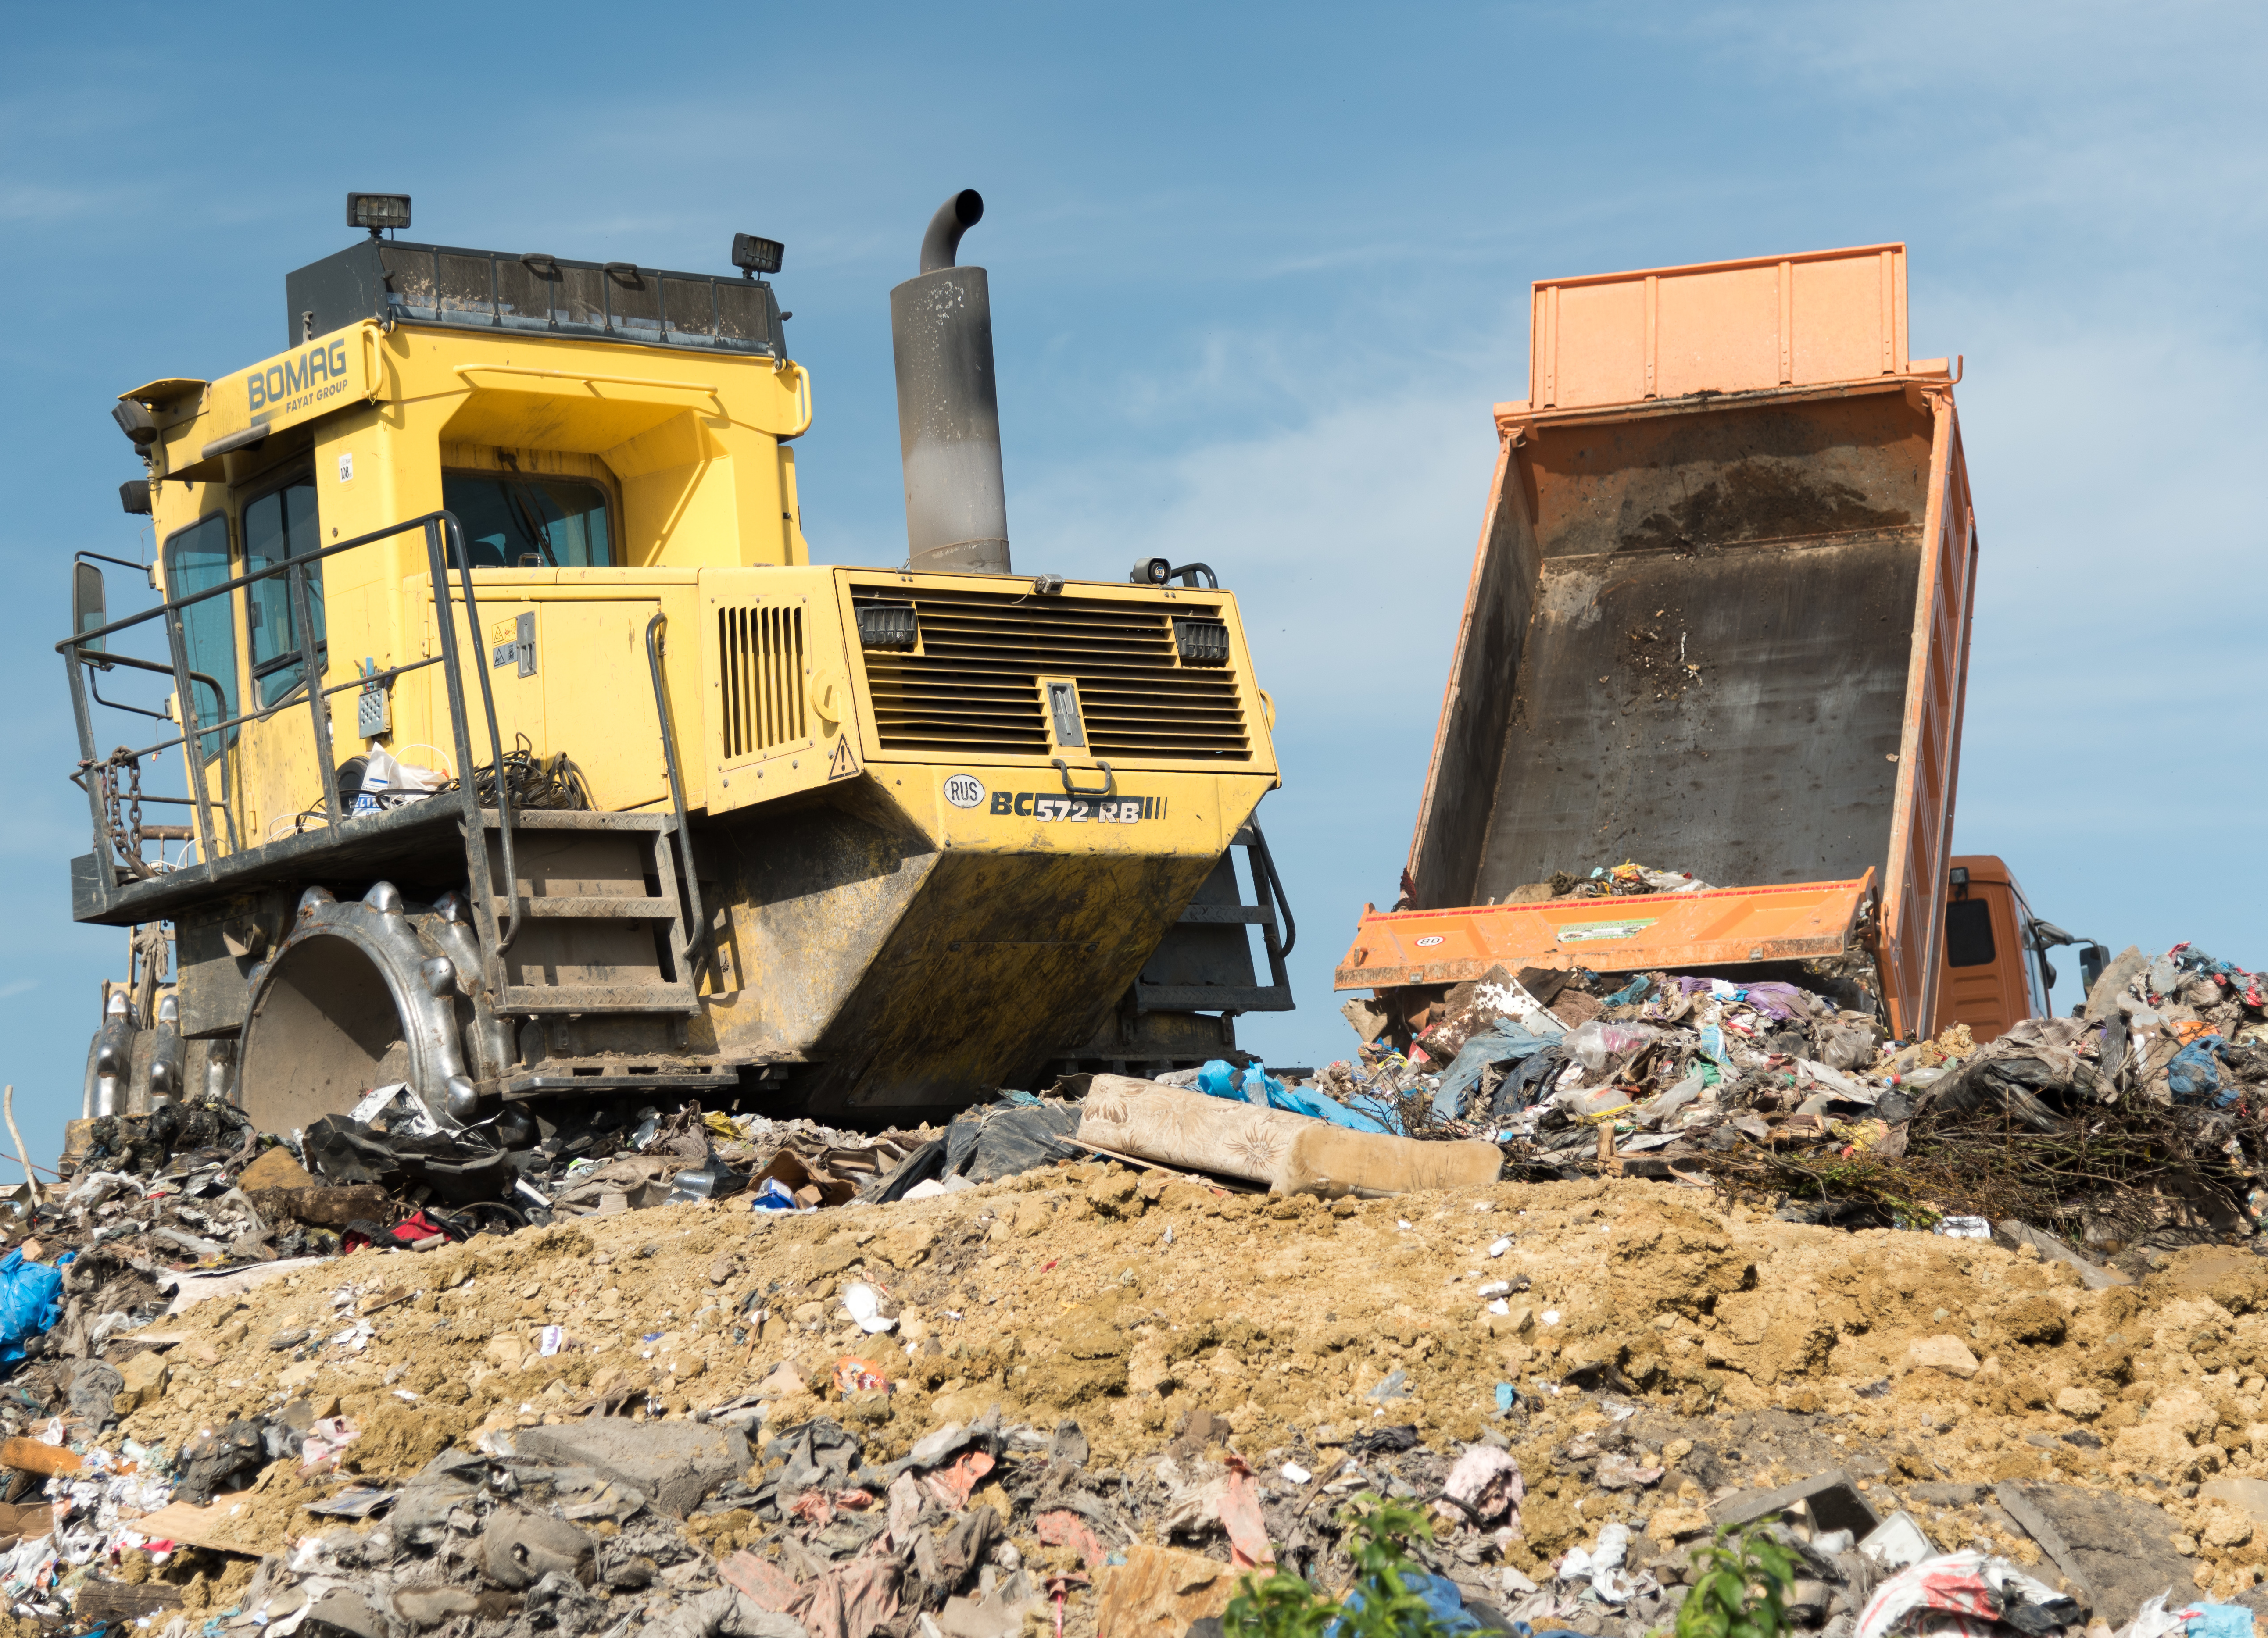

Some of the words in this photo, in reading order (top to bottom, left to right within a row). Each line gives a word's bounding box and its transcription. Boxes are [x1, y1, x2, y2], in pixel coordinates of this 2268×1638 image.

[248, 338, 346, 411] BOMAG
[286, 393, 313, 414] FAYAT
[317, 379, 347, 401] GROUP
[951, 781, 977, 801] RUS
[1098, 802, 1139, 824] RB
